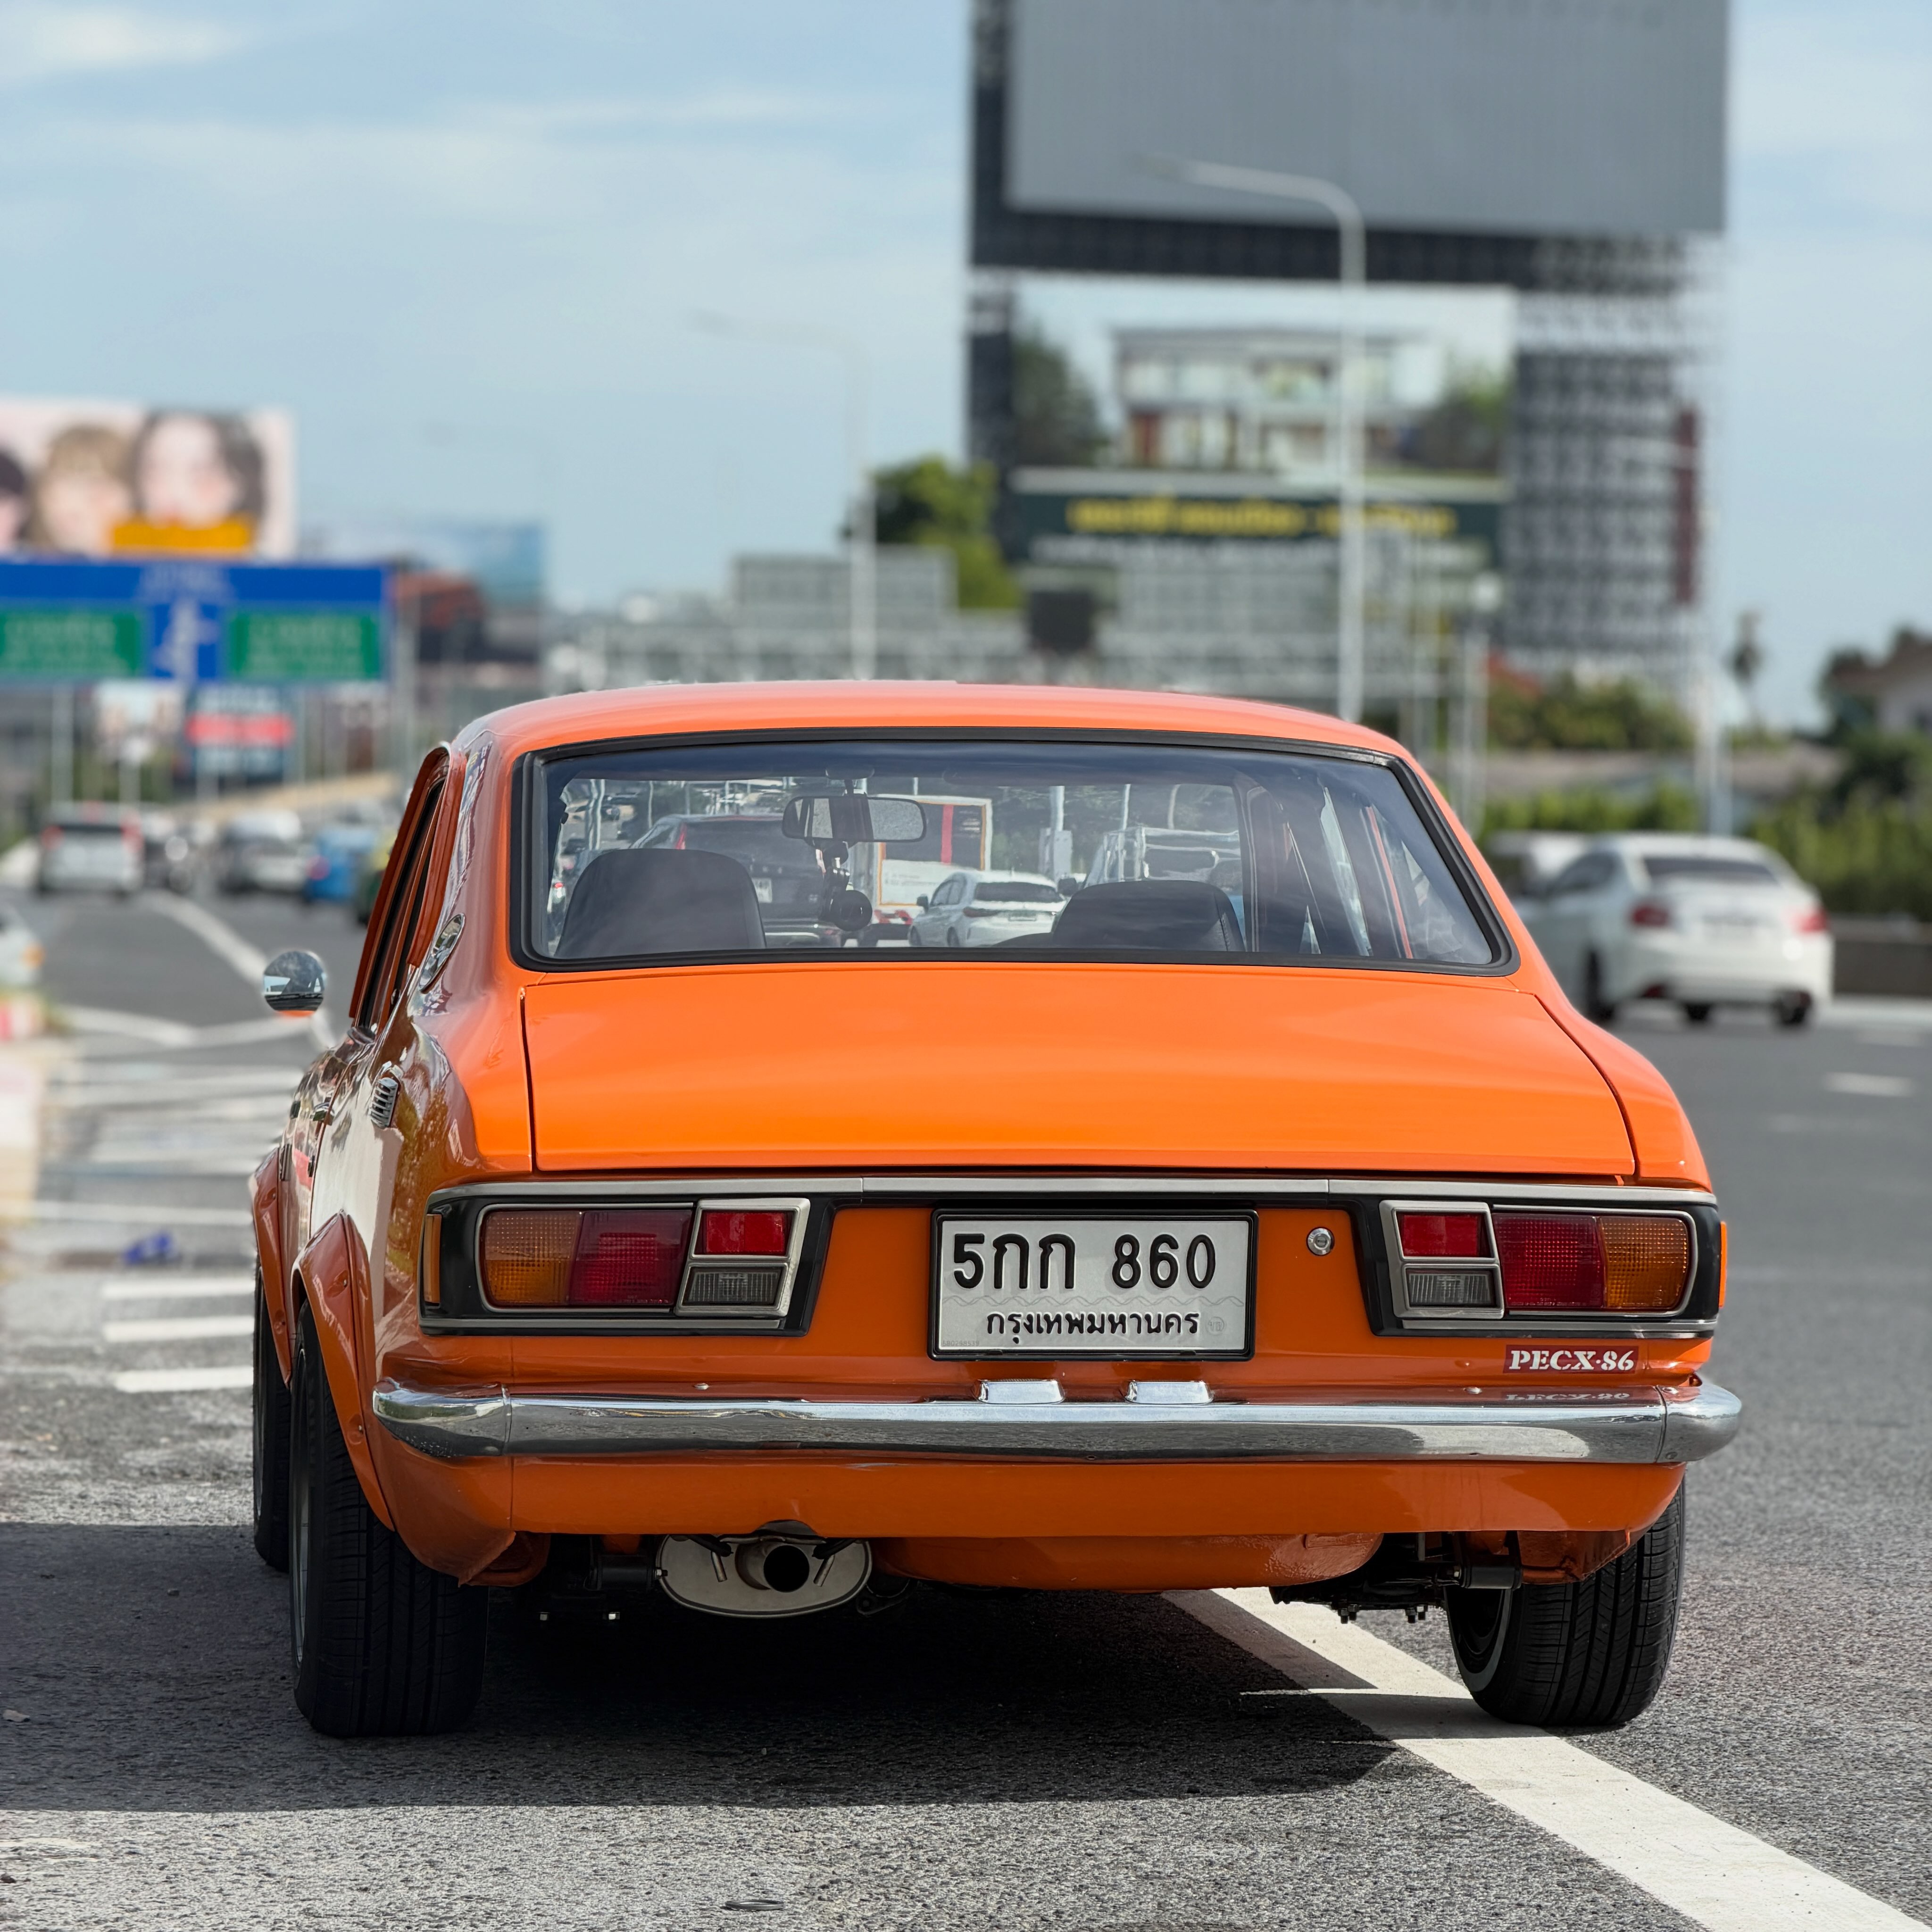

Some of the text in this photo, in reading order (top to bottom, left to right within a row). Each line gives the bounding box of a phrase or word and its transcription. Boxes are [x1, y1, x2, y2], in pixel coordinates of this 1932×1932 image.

[954, 1233, 1216, 1290] 5กก 860
[987, 1312, 1200, 1344] กรุงเทพมหานคร
